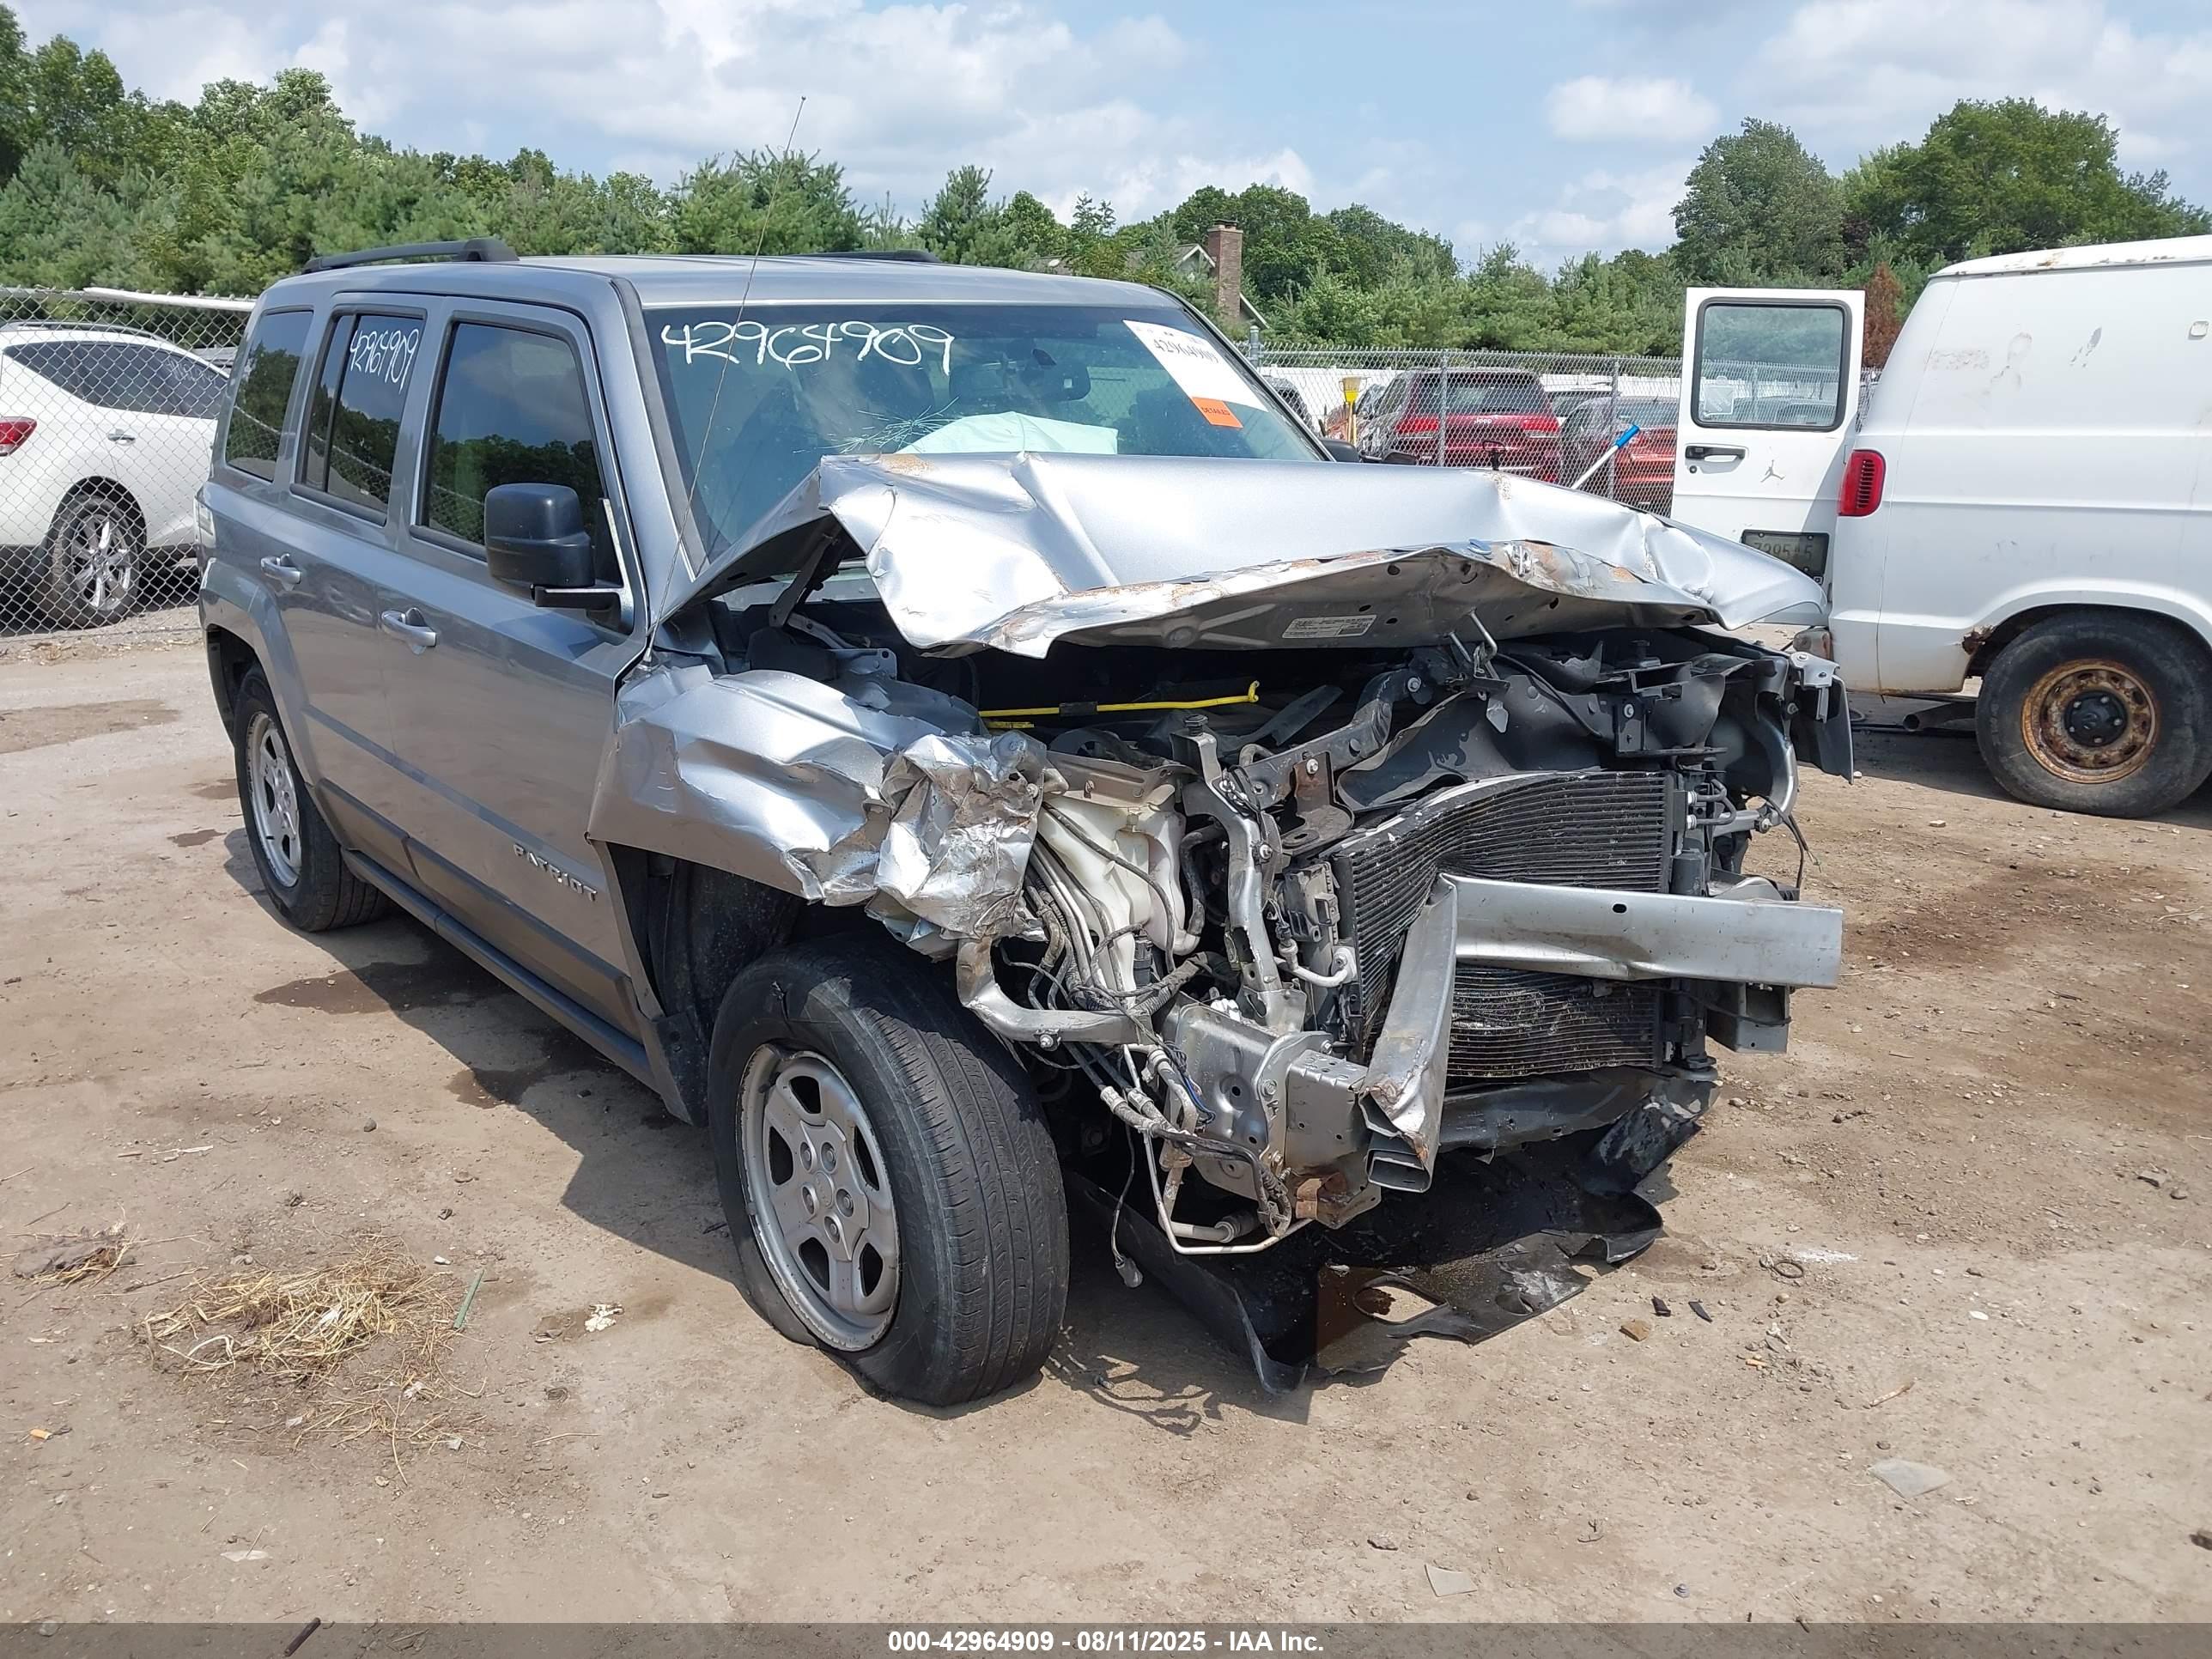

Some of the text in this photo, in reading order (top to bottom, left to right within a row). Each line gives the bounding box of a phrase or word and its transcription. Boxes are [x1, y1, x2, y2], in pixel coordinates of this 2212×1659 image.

[349, 328, 419, 394] 42964909
[661, 321, 954, 375] 42964909
[514, 844, 597, 902] PATRIOT
